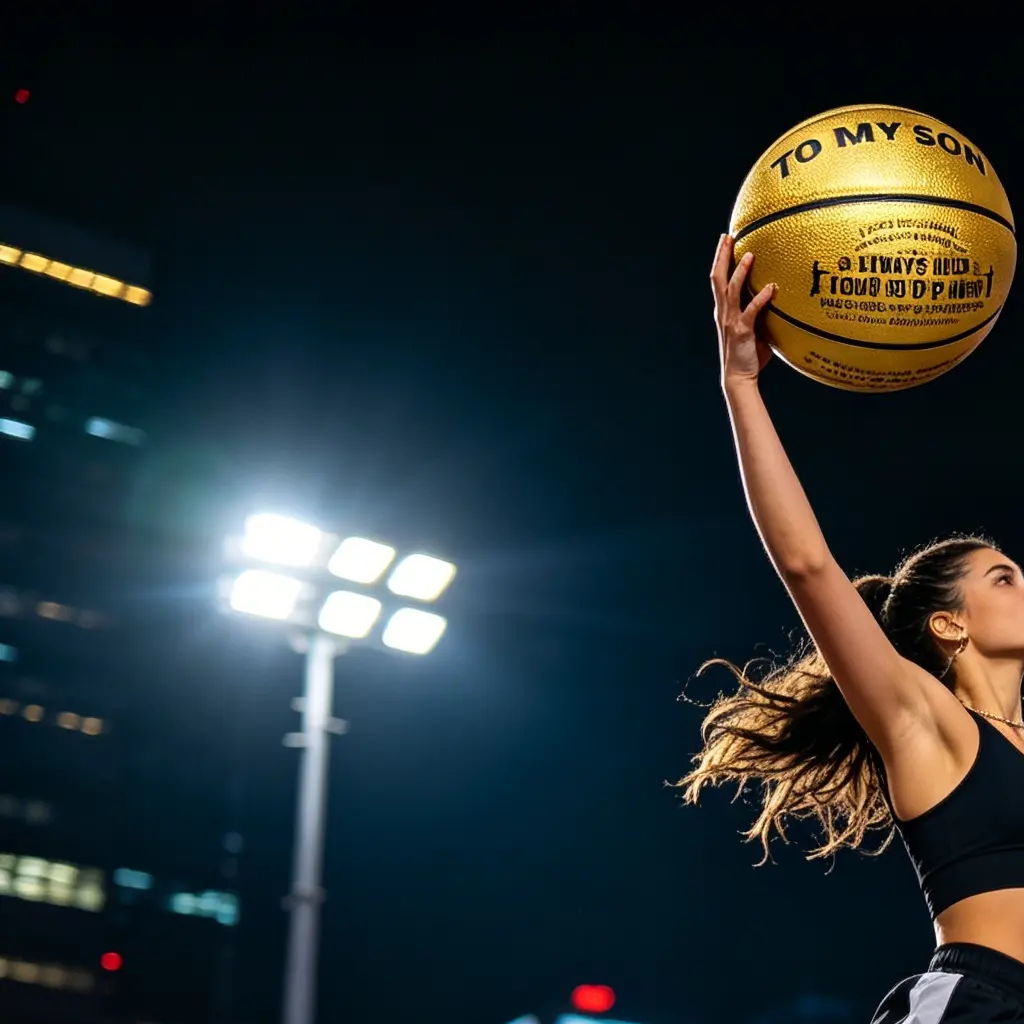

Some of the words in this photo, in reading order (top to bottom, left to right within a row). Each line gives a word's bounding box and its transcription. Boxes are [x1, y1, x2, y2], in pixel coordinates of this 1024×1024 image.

[770, 138, 823, 179] TO
[832, 122, 902, 148] MY
[912, 124, 987, 177] SON
